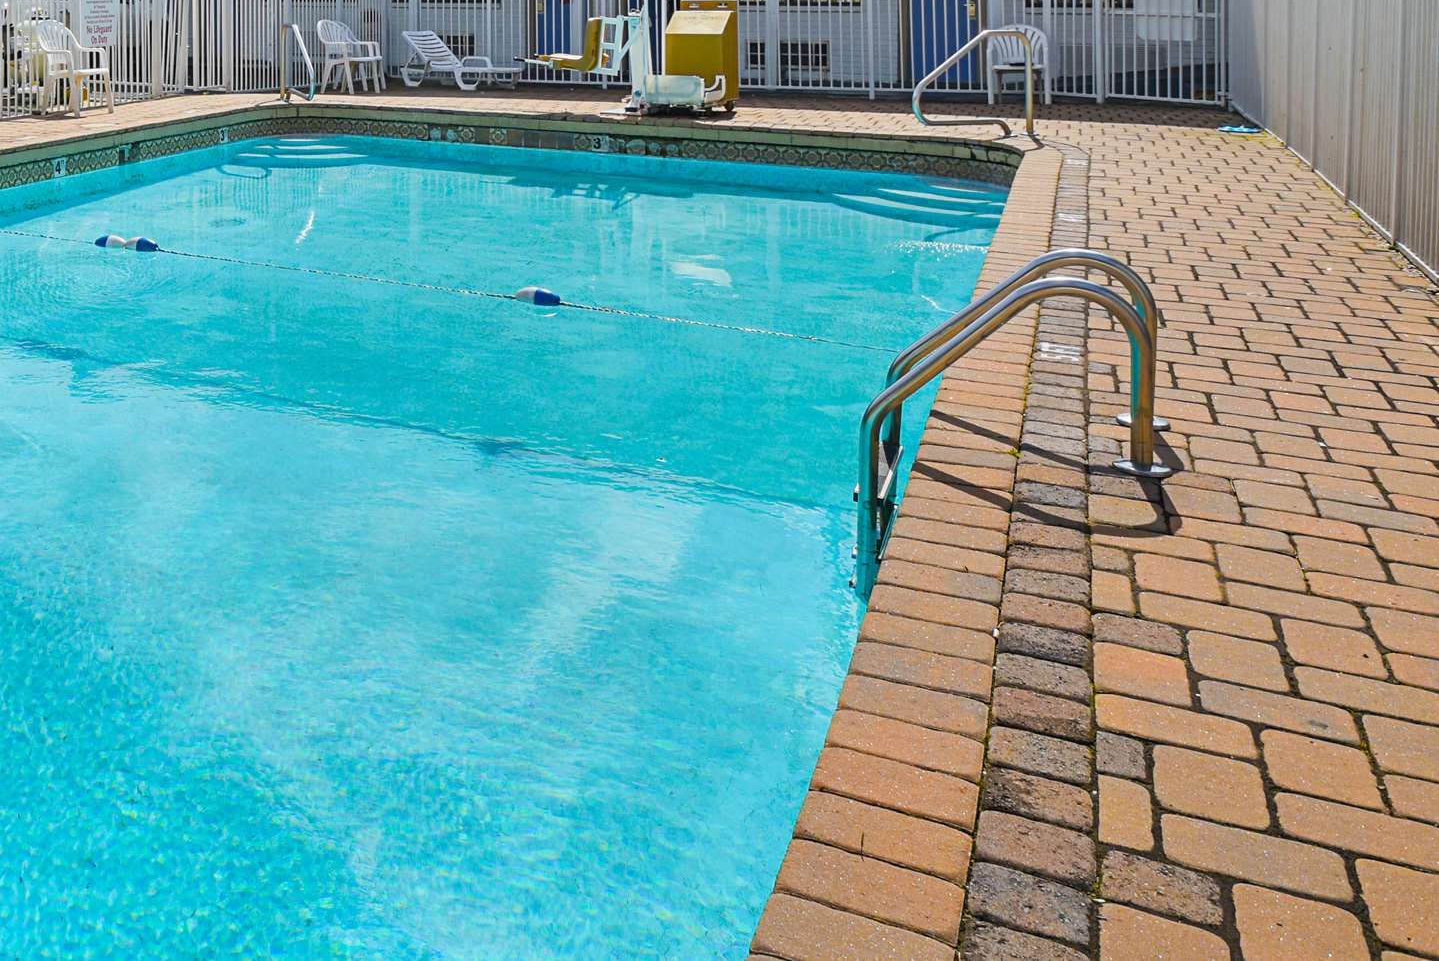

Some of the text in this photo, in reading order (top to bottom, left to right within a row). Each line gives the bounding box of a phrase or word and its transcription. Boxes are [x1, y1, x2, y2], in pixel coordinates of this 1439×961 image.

[86, 25, 92, 34] No
[593, 137, 601, 149] 3
[55, 160, 62, 175] 4
